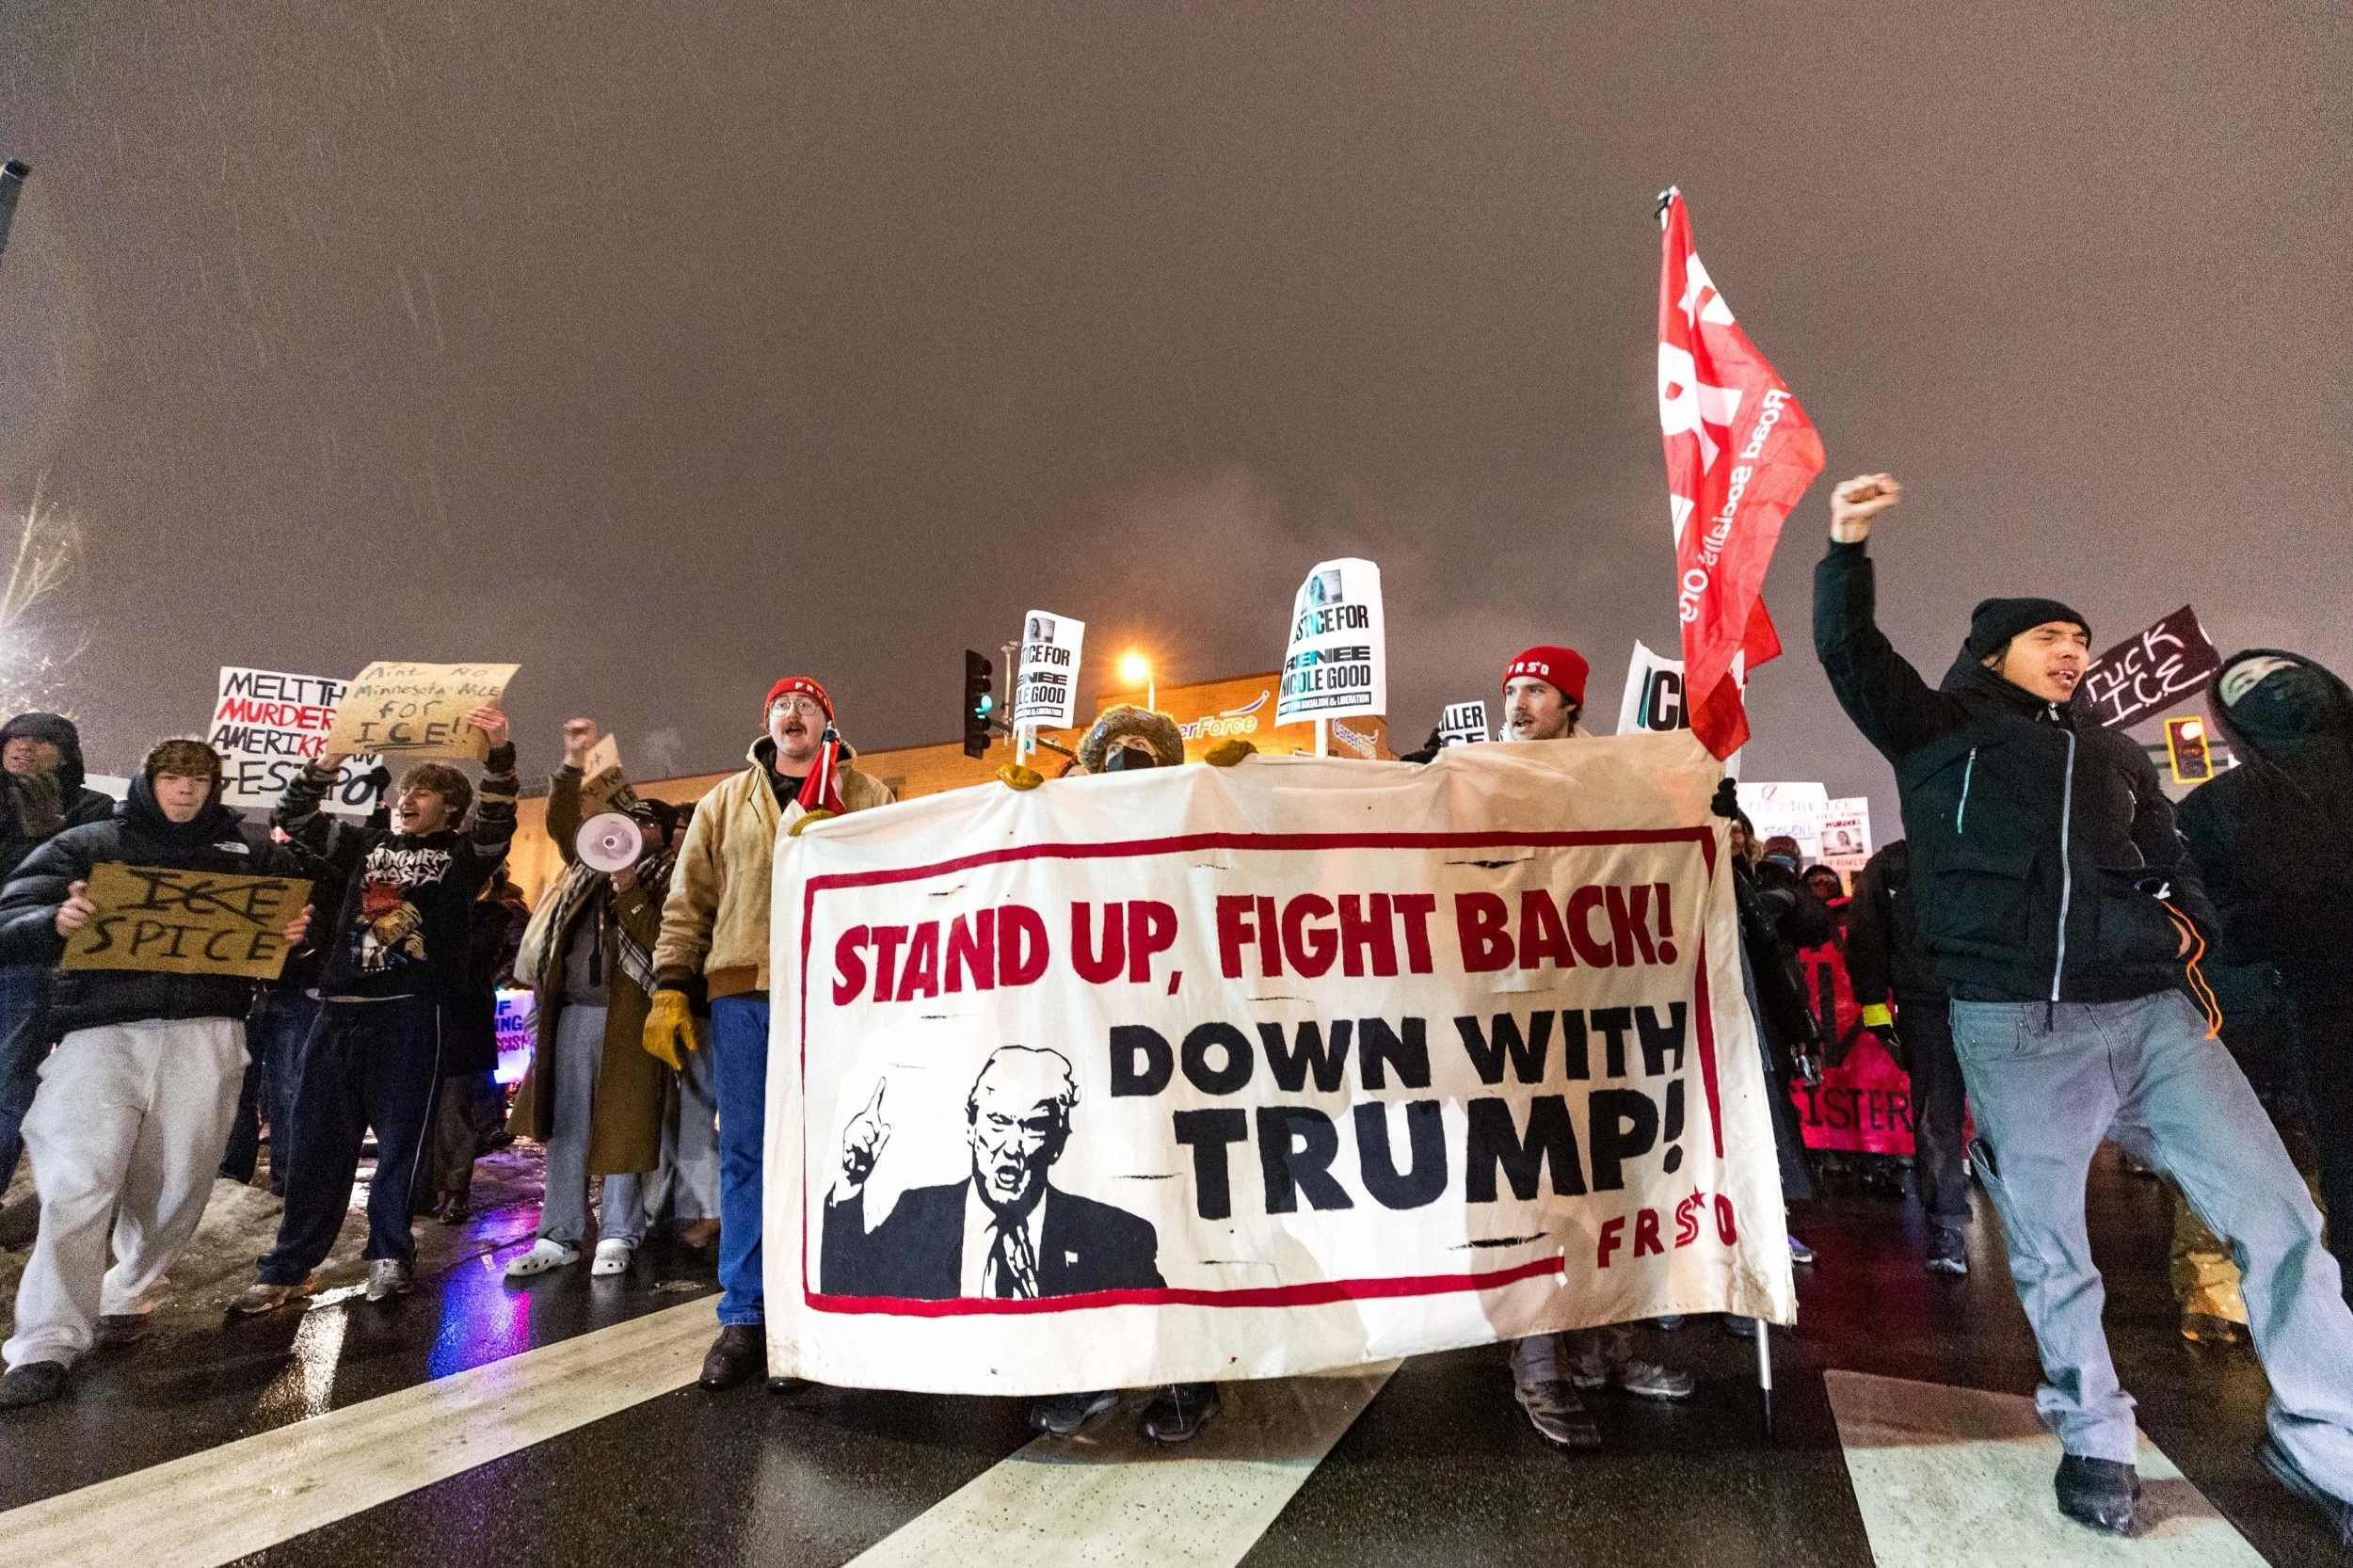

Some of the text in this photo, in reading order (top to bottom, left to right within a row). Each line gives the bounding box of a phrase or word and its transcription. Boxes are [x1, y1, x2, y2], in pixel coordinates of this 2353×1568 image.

[1293, 604, 1369, 644] STICE FOR
[1021, 645, 1071, 666] TICE FOR
[1286, 646, 1370, 675] RENEE
[2086, 623, 2185, 702] FUCK
[223, 672, 346, 707] MELT TH
[1017, 671, 1067, 687] ENEE
[1031, 685, 1065, 705] GOOD
[1281, 664, 1371, 699] NICOLE GOOD
[216, 697, 336, 731] MURDER
[1337, 694, 1370, 707] LIBERATION
[1637, 665, 1692, 731] IC
[1178, 715, 1257, 739] erForce
[1442, 705, 1484, 732] ILLER
[83, 916, 285, 961] SPICE
[832, 882, 1678, 1006] STAND UP, FIGHT BACK!
[495, 1015, 523, 1032] ING
[498, 1000, 511, 1016] F
[1110, 1001, 1687, 1097] DOWN WITH
[1792, 1084, 1913, 1133] ISTER
[1173, 1078, 1685, 1220] TRUMP!
